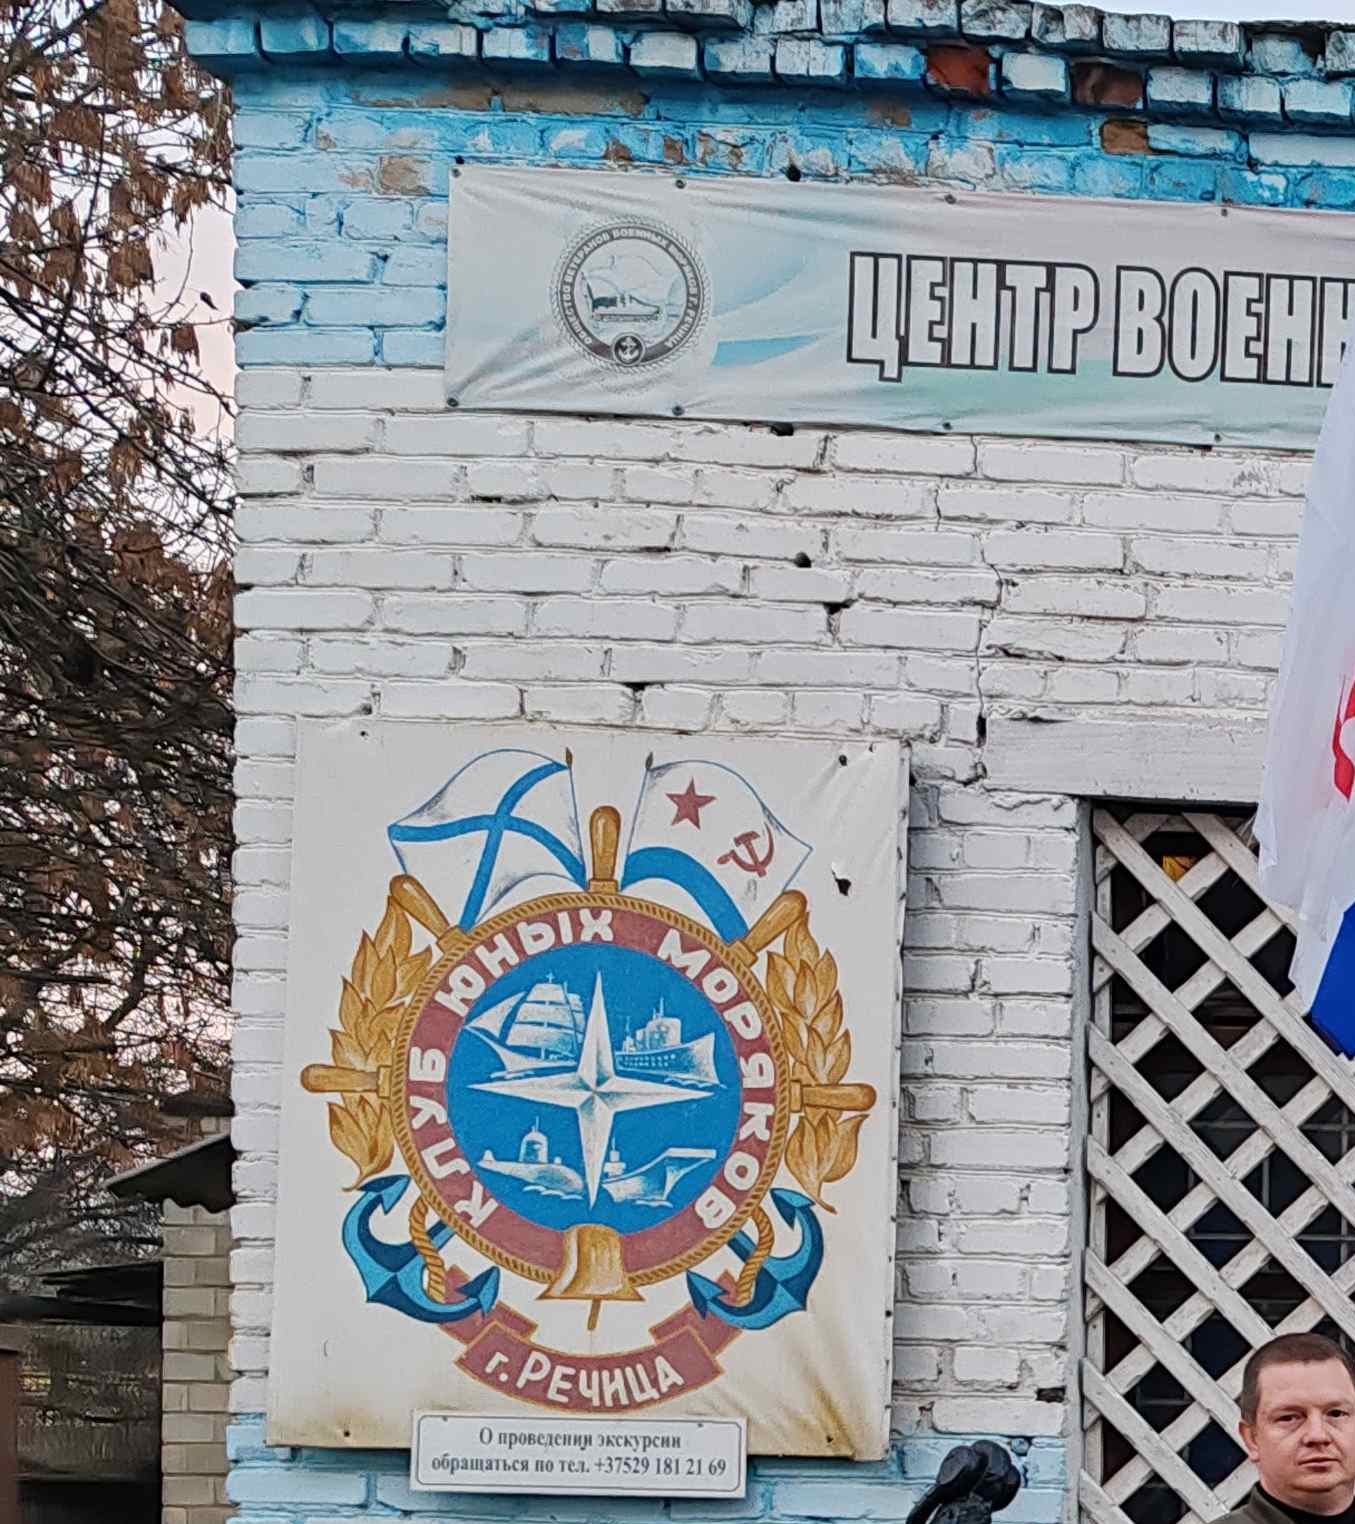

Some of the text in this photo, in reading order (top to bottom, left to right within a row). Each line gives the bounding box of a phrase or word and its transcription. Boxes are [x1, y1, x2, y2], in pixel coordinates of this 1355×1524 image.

[564, 231, 611, 283] ВЕТЕРАНОВ
[612, 227, 669, 249] ВОЕННЫХ
[847, 251, 1100, 383] ЦЕНТР
[408, 908, 775, 1231] КЛУБ ЮНЫХ МОРЯКОВ
[515, 1350, 686, 1408] РЕЧИЦА
[431, 1454, 726, 1476] обращаться по тел. +37529 181 21 69
[479, 1427, 682, 1452] О проведении экскурсии
